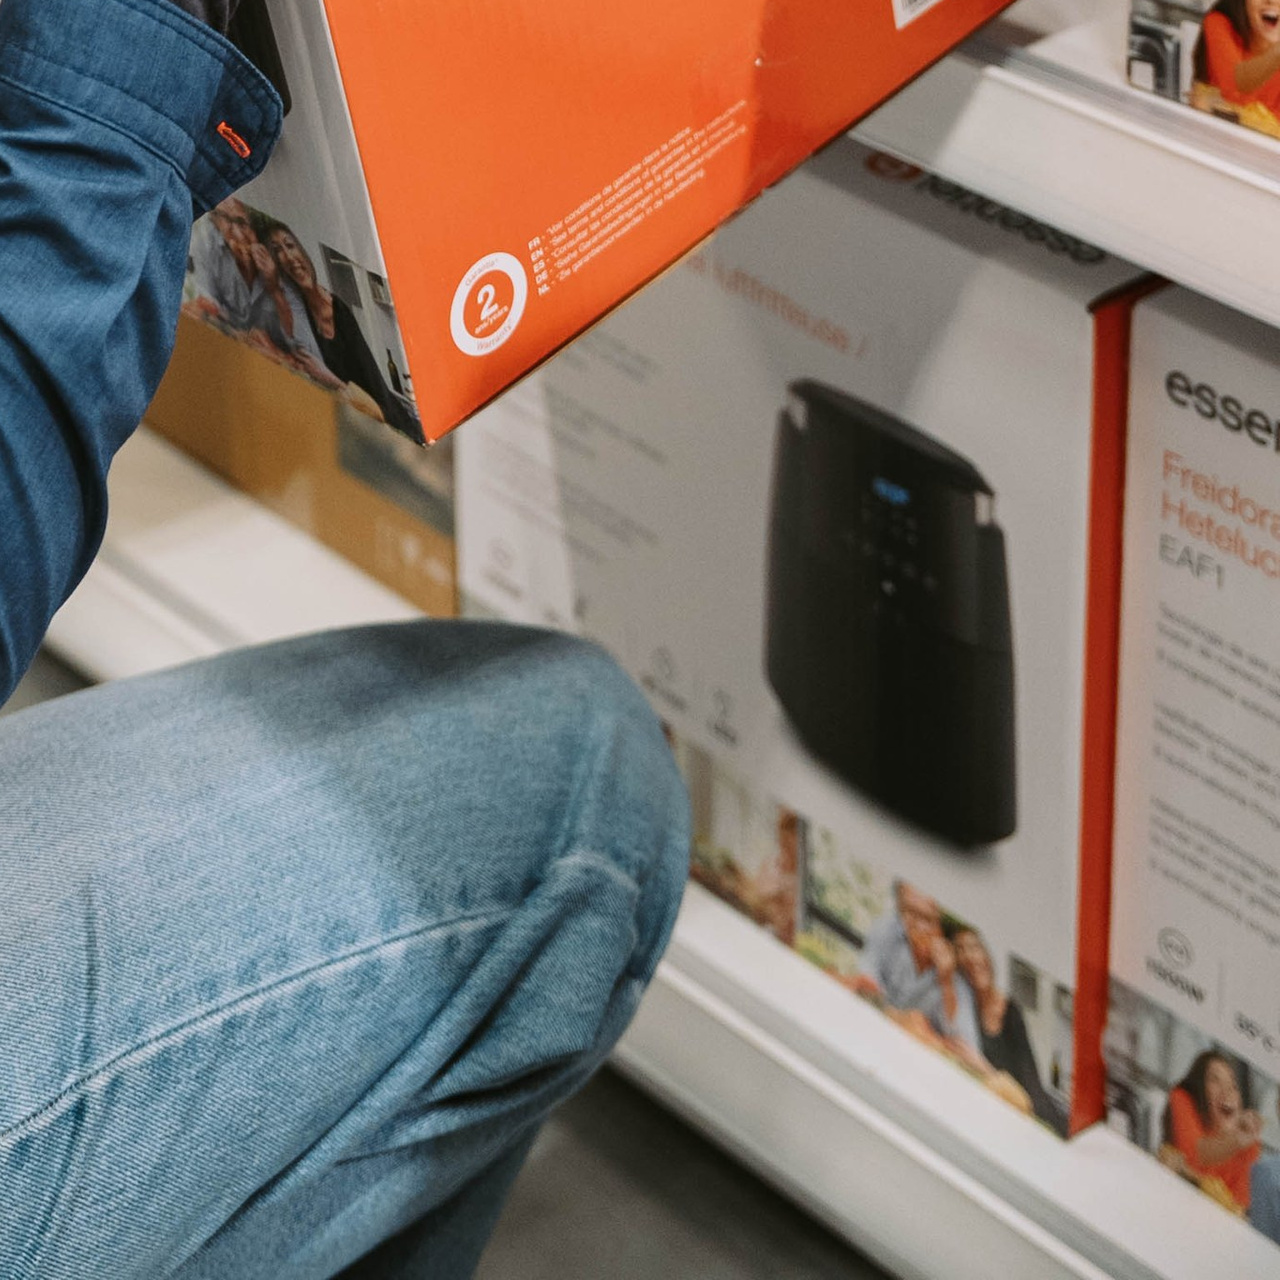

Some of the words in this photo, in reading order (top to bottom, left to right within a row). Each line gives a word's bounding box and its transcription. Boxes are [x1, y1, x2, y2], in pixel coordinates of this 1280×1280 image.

[564, 193, 601, 225] conditions
[613, 162, 642, 190] garantie
[567, 215, 589, 235] terms
[604, 176, 641, 207] conditions
[477, 283, 499, 321] 2
